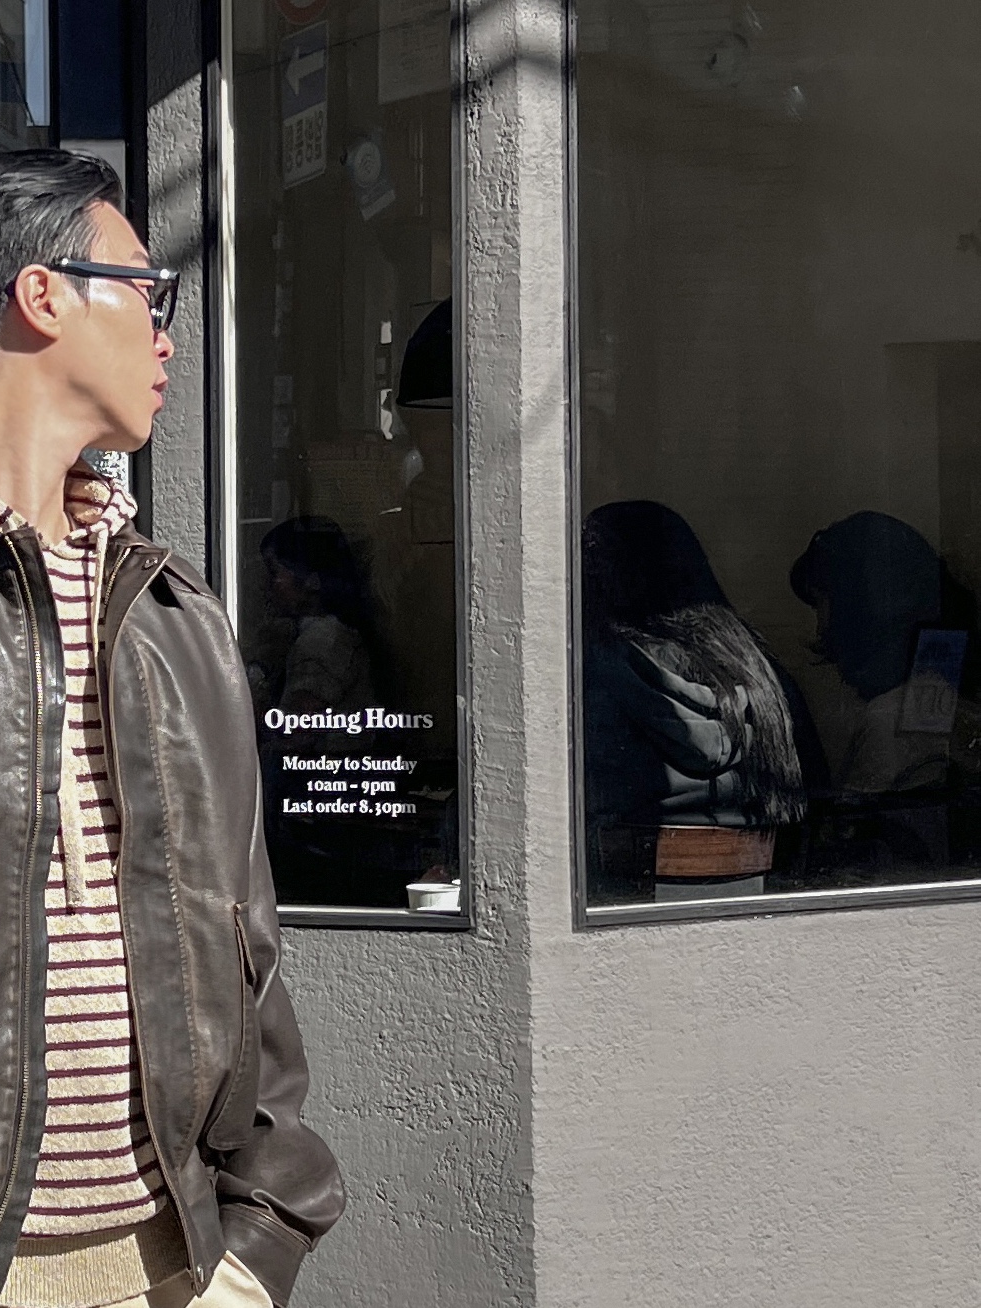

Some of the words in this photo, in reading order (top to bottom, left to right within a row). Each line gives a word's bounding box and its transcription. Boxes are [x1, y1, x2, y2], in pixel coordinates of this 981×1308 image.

[264, 708, 362, 735] Opening
[365, 707, 434, 729] Hours
[282, 755, 342, 775] Monday
[344, 758, 360, 771] to
[361, 755, 418, 775] Sunday
[306, 780, 348, 792] 10am
[360, 781, 396, 796] 9pm
[282, 798, 315, 813] Last
[315, 798, 357, 813] order
[358, 798, 417, 818] 8.30pm
